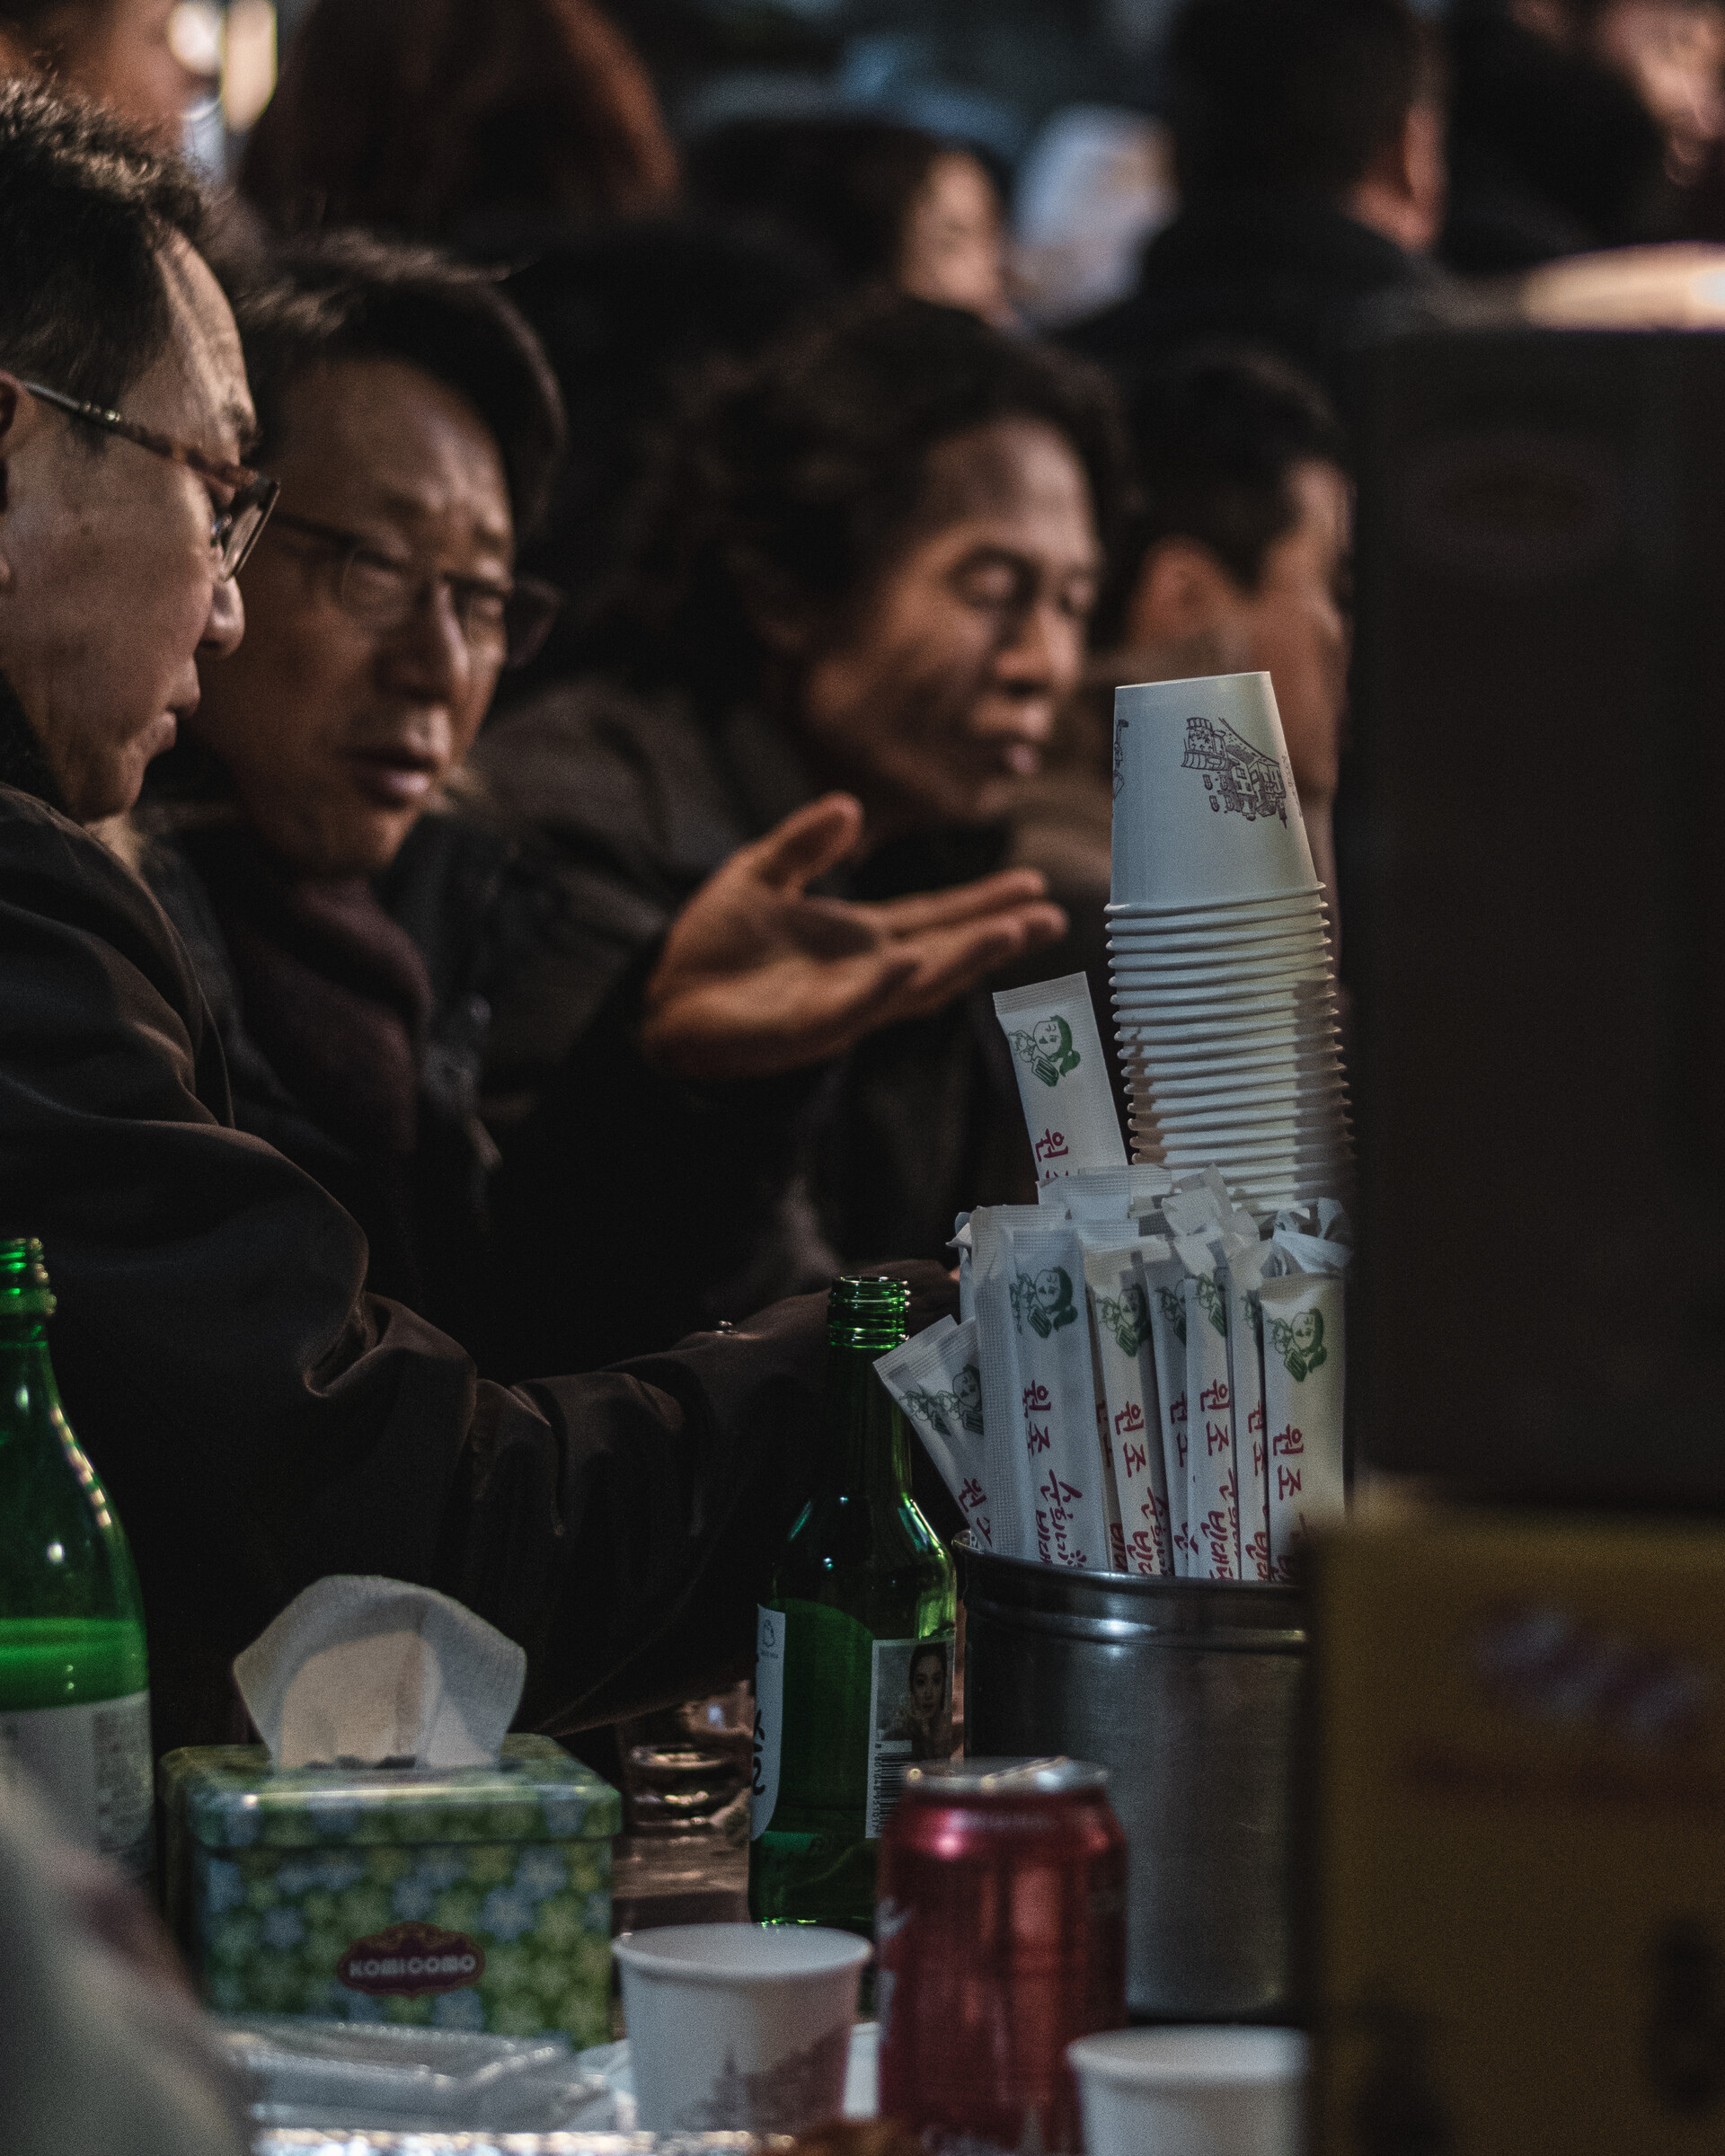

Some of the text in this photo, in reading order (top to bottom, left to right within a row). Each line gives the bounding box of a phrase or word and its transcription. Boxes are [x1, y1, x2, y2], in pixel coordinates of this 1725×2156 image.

[1022, 1379, 1052, 1457] 원조
[1115, 1401, 1146, 1478] 원조
[1200, 1379, 1231, 1457] 원조
[1273, 1424, 1304, 1500] 원조
